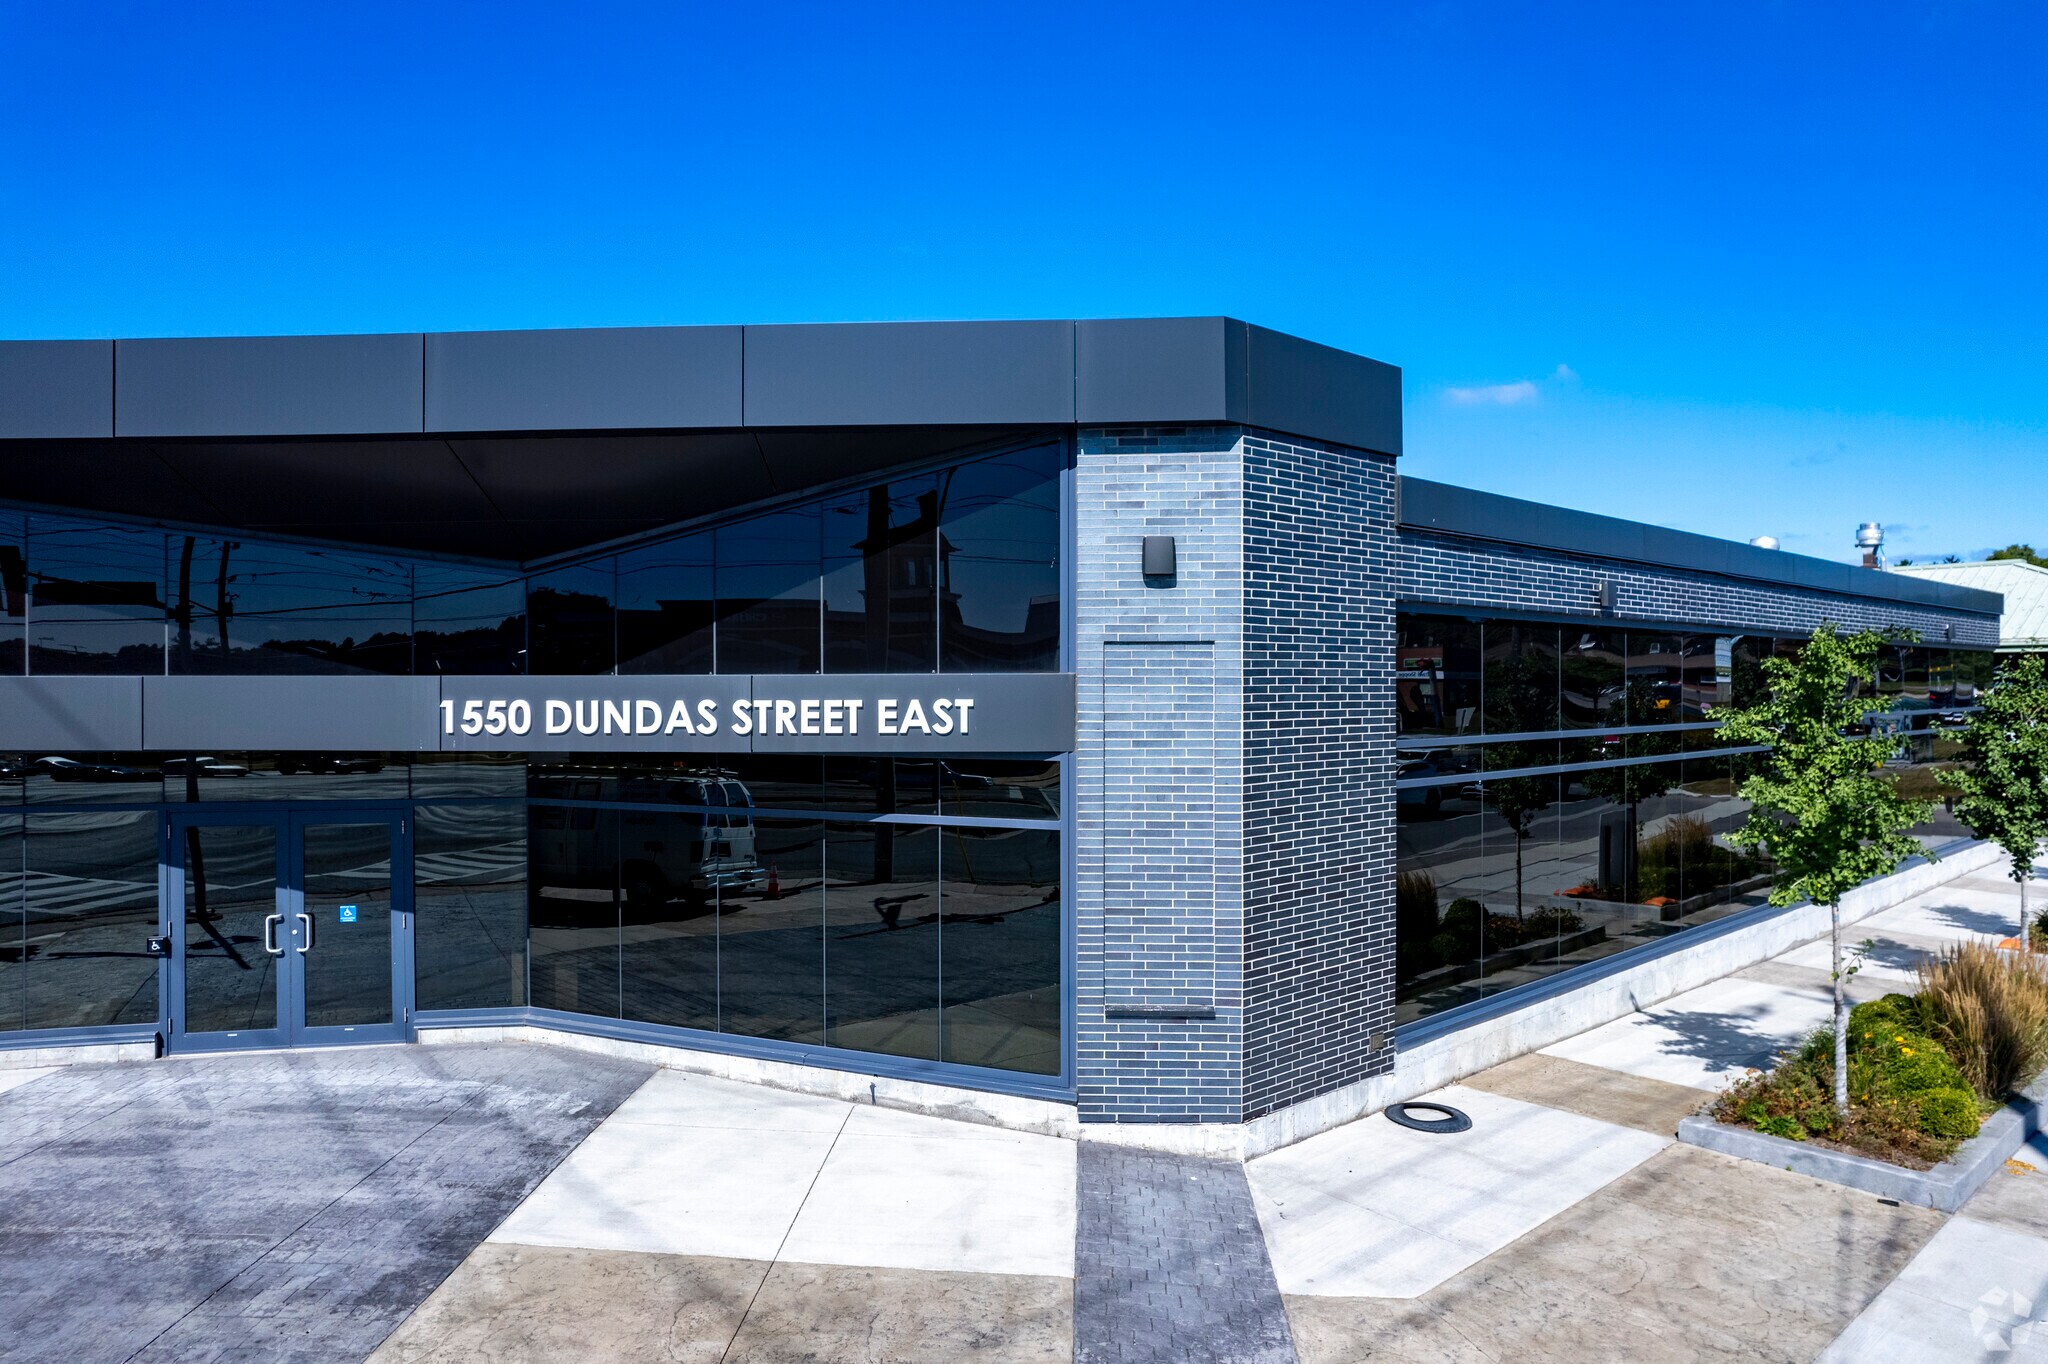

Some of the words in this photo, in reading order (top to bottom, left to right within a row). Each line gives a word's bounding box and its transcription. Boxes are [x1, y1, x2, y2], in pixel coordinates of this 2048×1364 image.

[439, 699, 532, 735] 1550
[545, 699, 718, 735] DUNDAS
[731, 698, 863, 735] STREET
[877, 698, 974, 735] EAST
